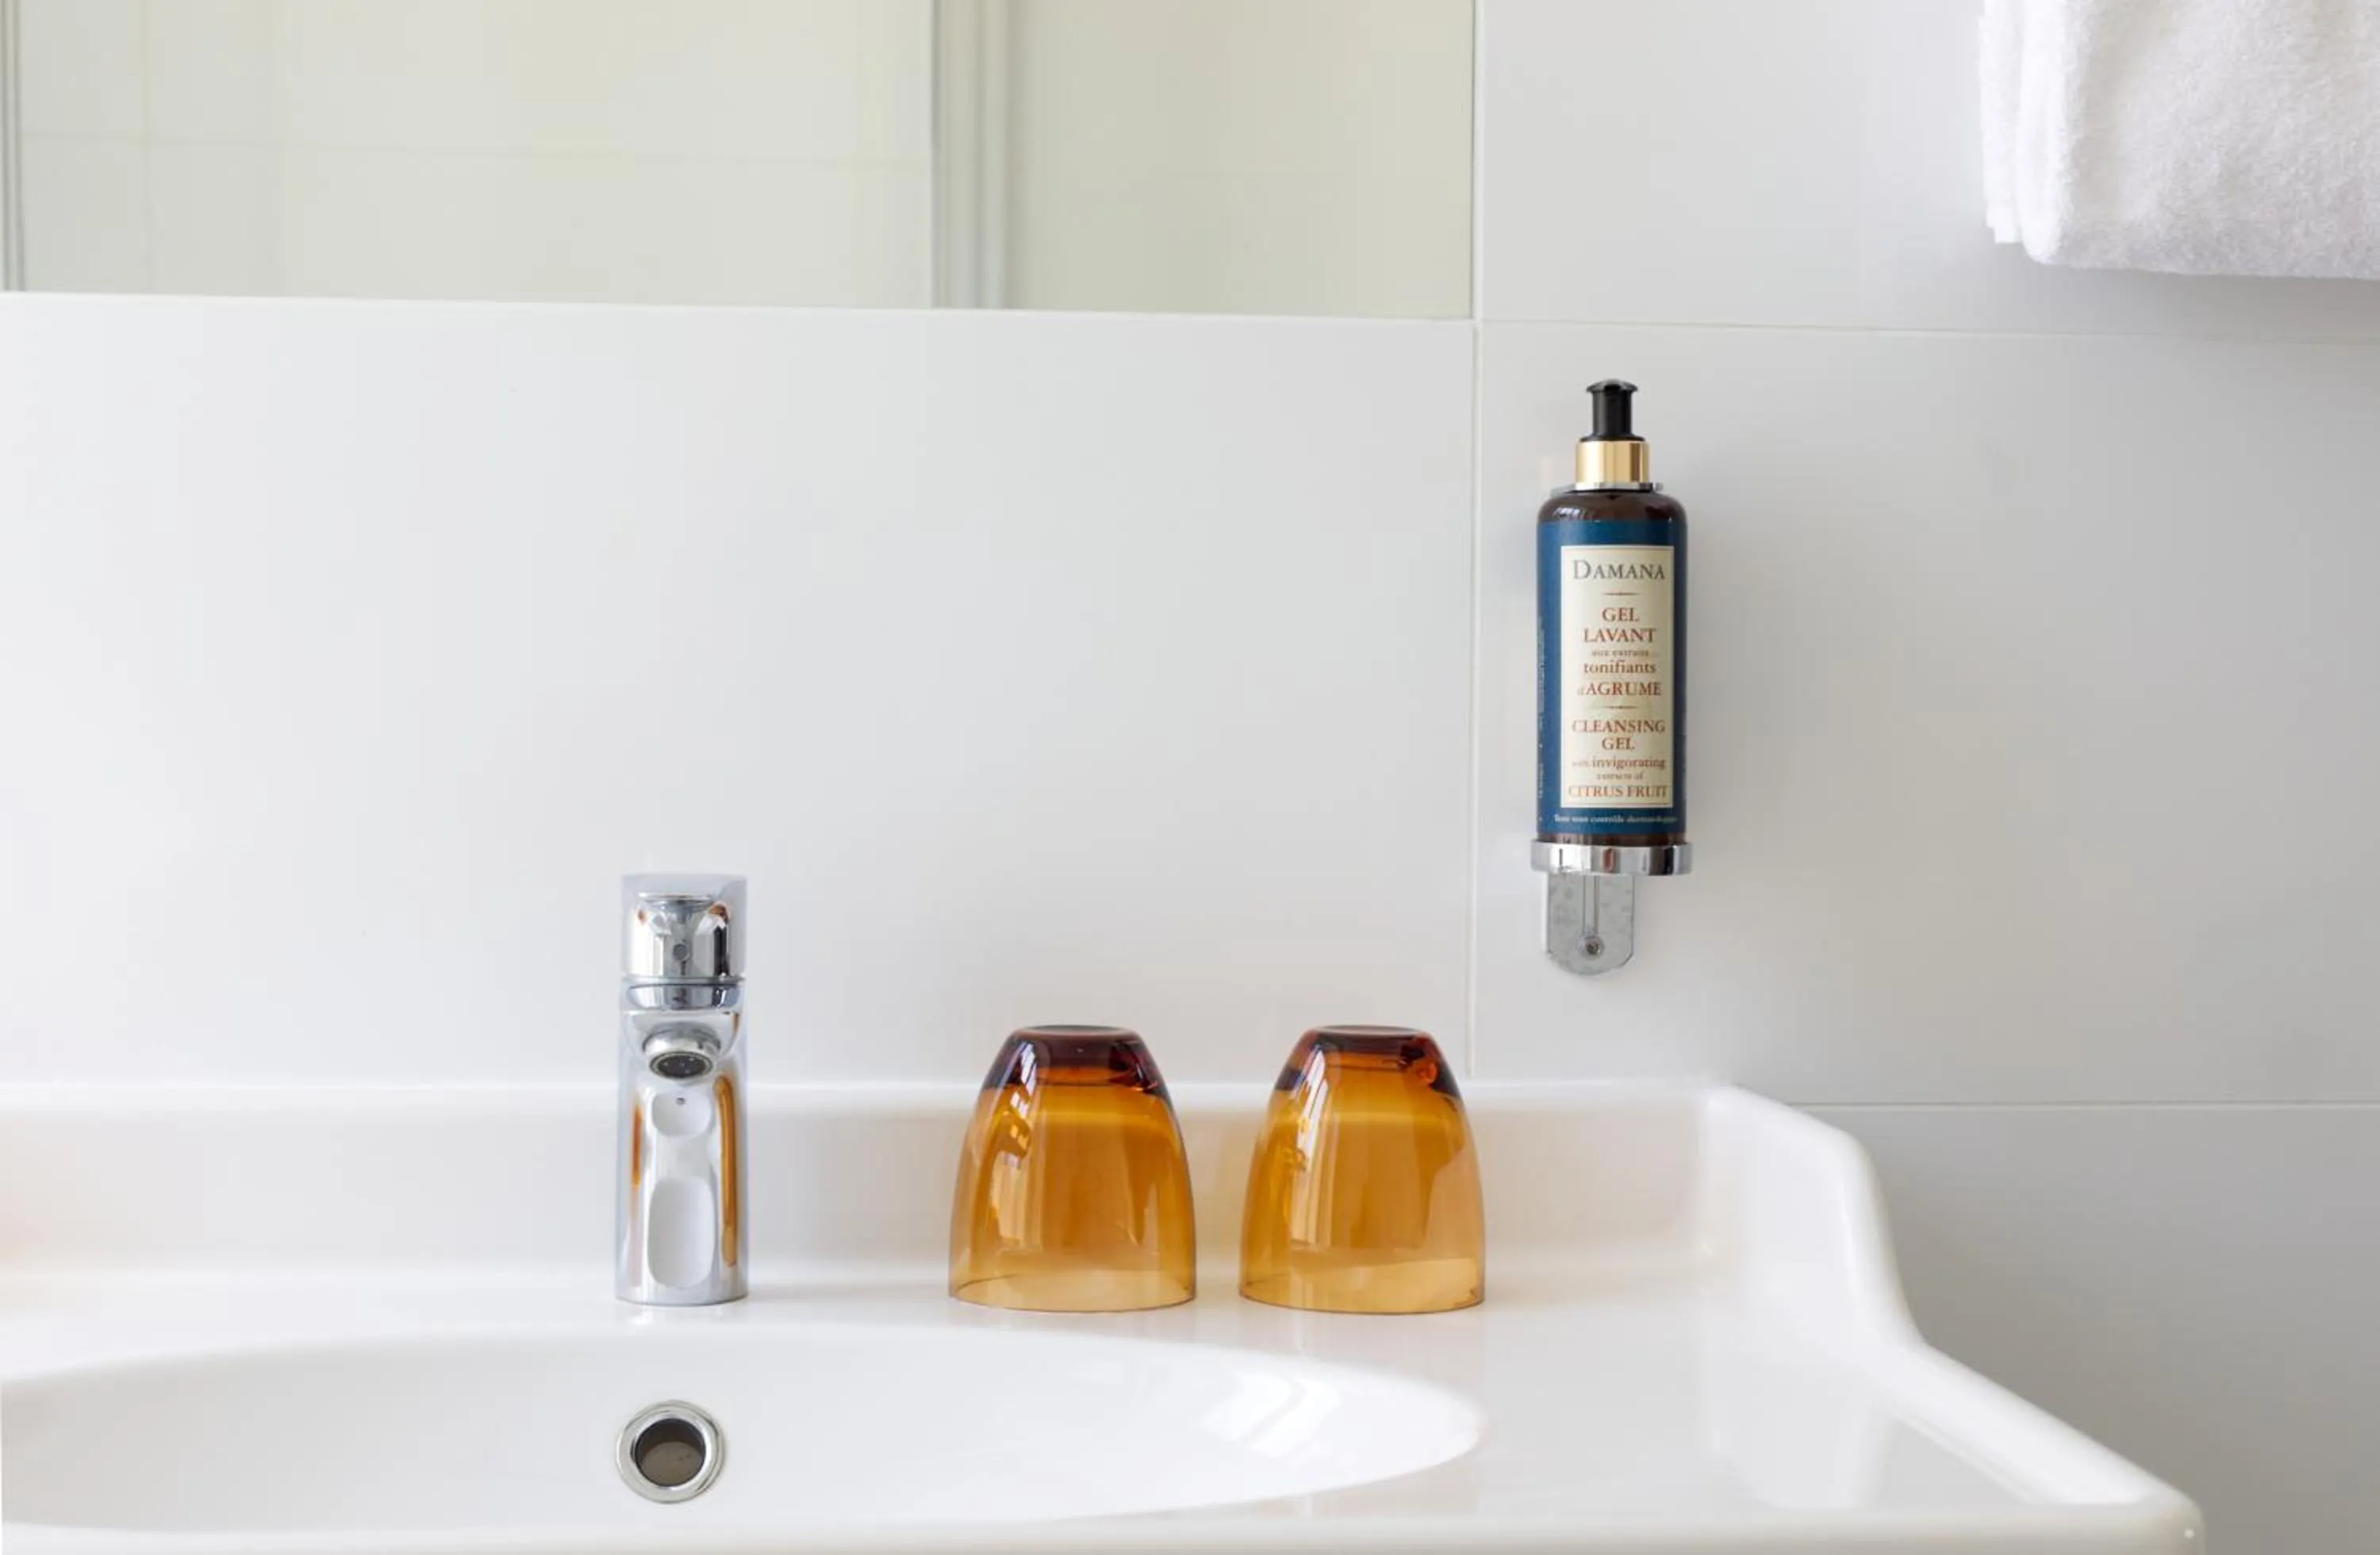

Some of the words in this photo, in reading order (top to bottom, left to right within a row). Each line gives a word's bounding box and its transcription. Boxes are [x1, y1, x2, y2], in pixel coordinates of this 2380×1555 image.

[1602, 608, 1640, 622] GEL
[1583, 628, 1656, 643] LAVANT
[1583, 659, 1656, 673] tonifiants
[1572, 720, 1666, 733] CLEANSING
[1602, 737, 1636, 750] GEL
[1592, 755, 1665, 770] invigorating
[1568, 785, 1623, 797] CITRUS
[1627, 785, 1668, 797] FRUIT
